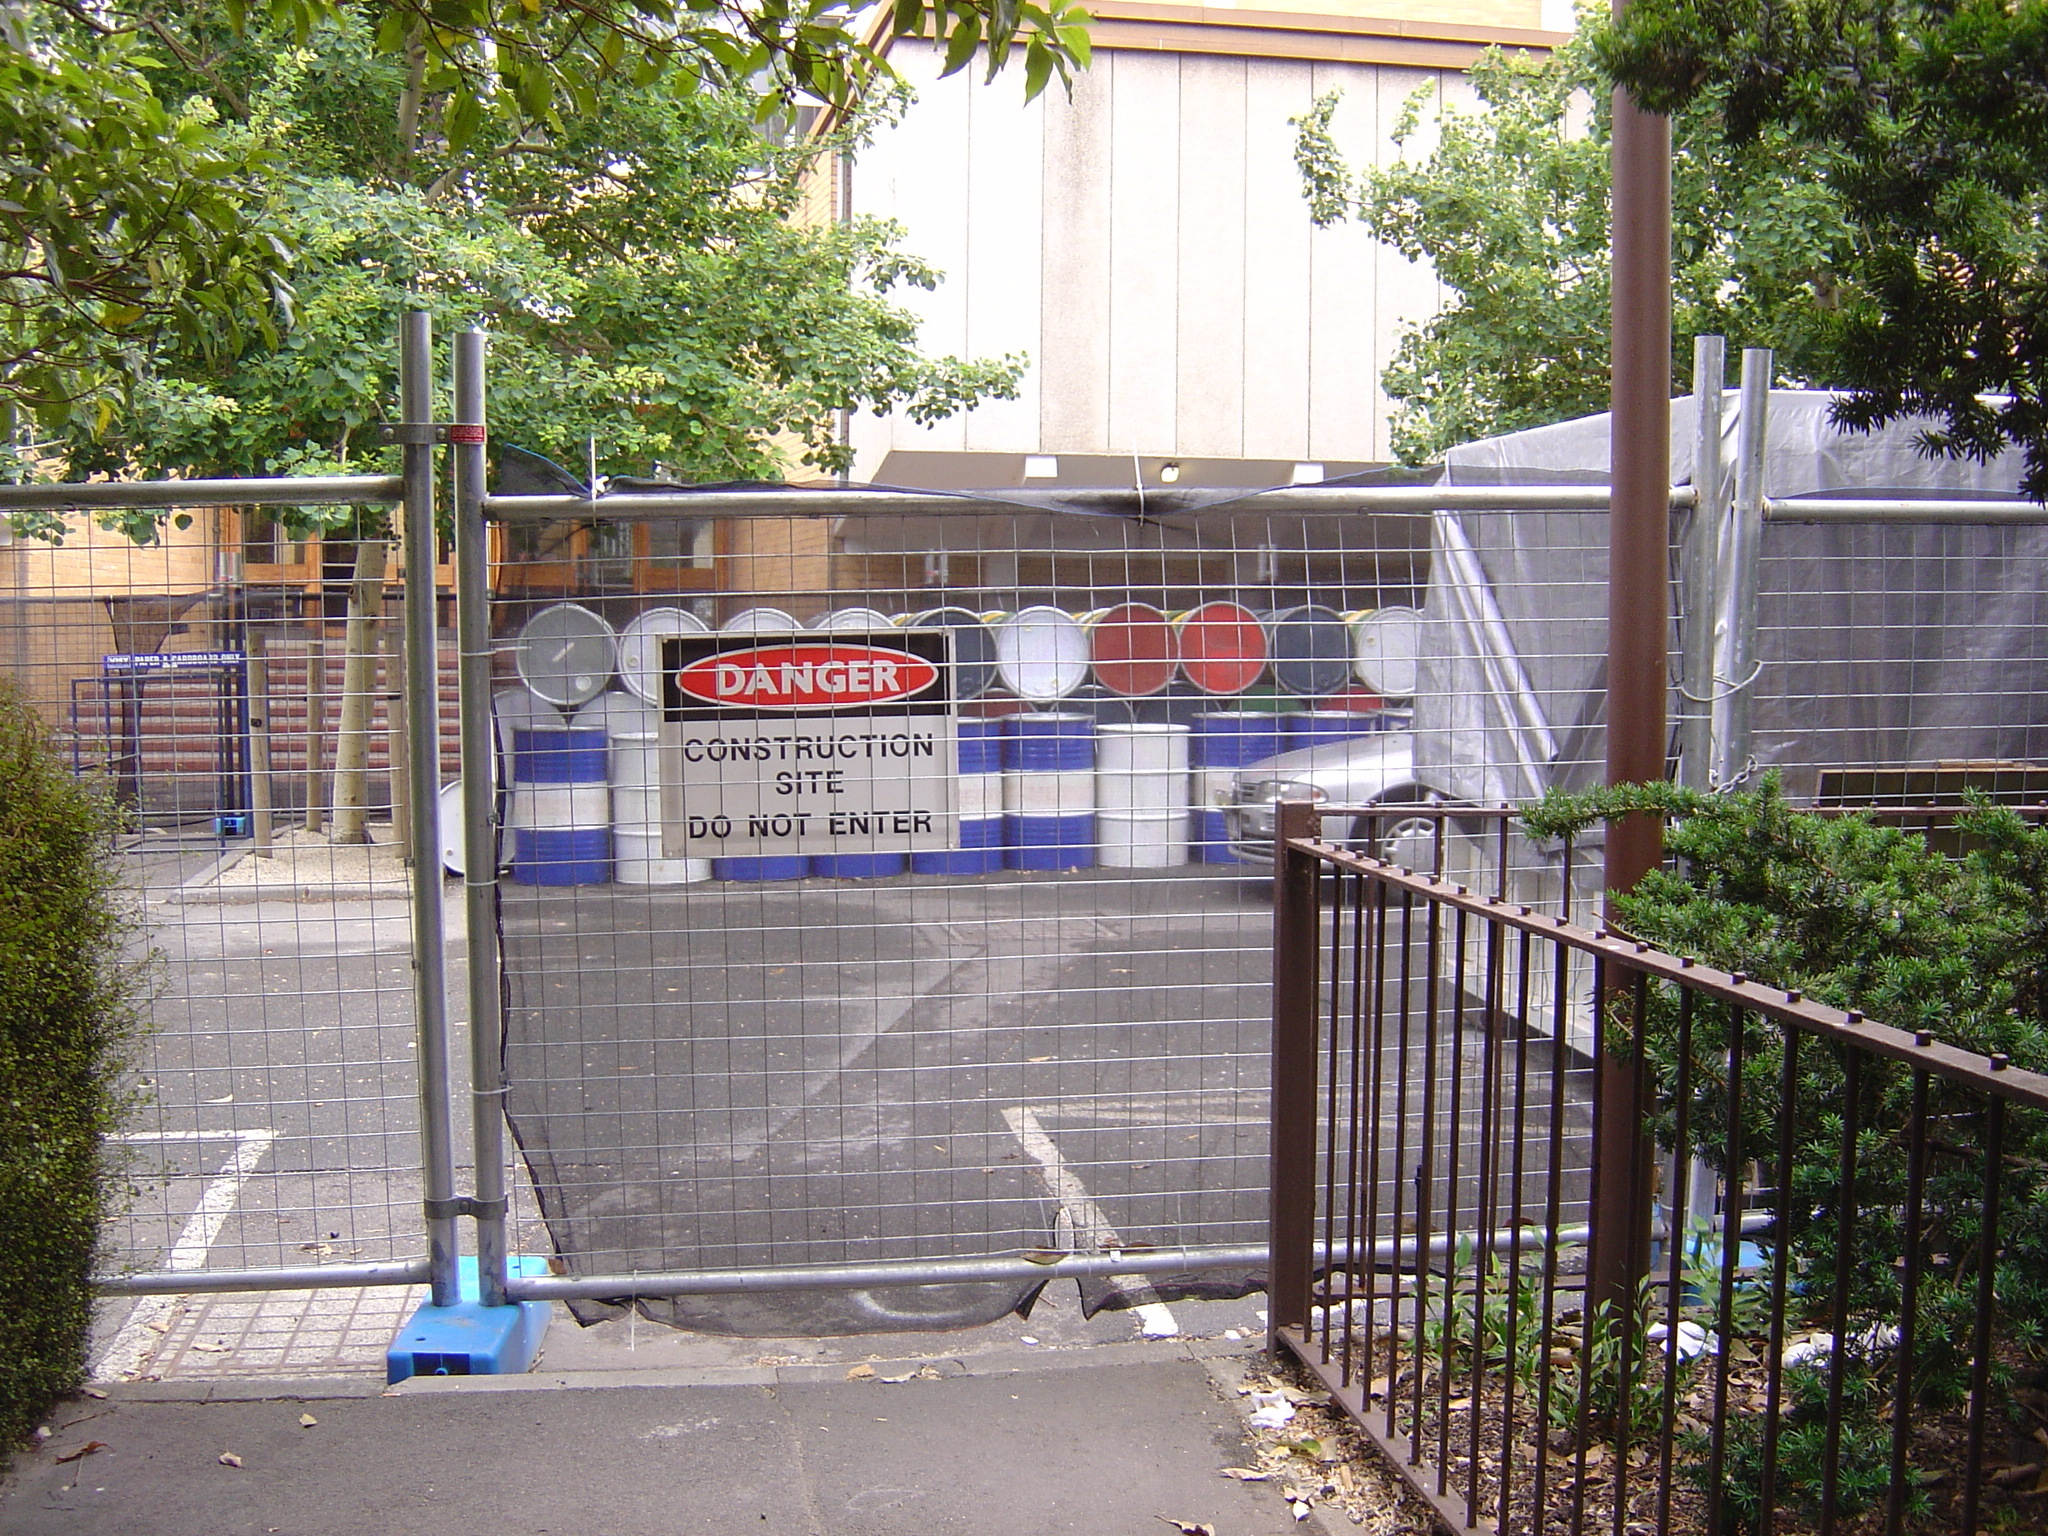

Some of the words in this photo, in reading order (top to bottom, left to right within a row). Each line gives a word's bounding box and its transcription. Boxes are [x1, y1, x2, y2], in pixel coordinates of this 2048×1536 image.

[134, 656, 160, 666] PAPER
[171, 654, 219, 664] CARDBOARD
[221, 653, 240, 664] ONLY
[715, 660, 900, 696] DANGER
[684, 733, 933, 762] CONSTRUCTION
[775, 770, 844, 795] SITE
[689, 814, 732, 839] DO
[749, 813, 811, 837] NOT
[829, 810, 932, 835] ENTER
